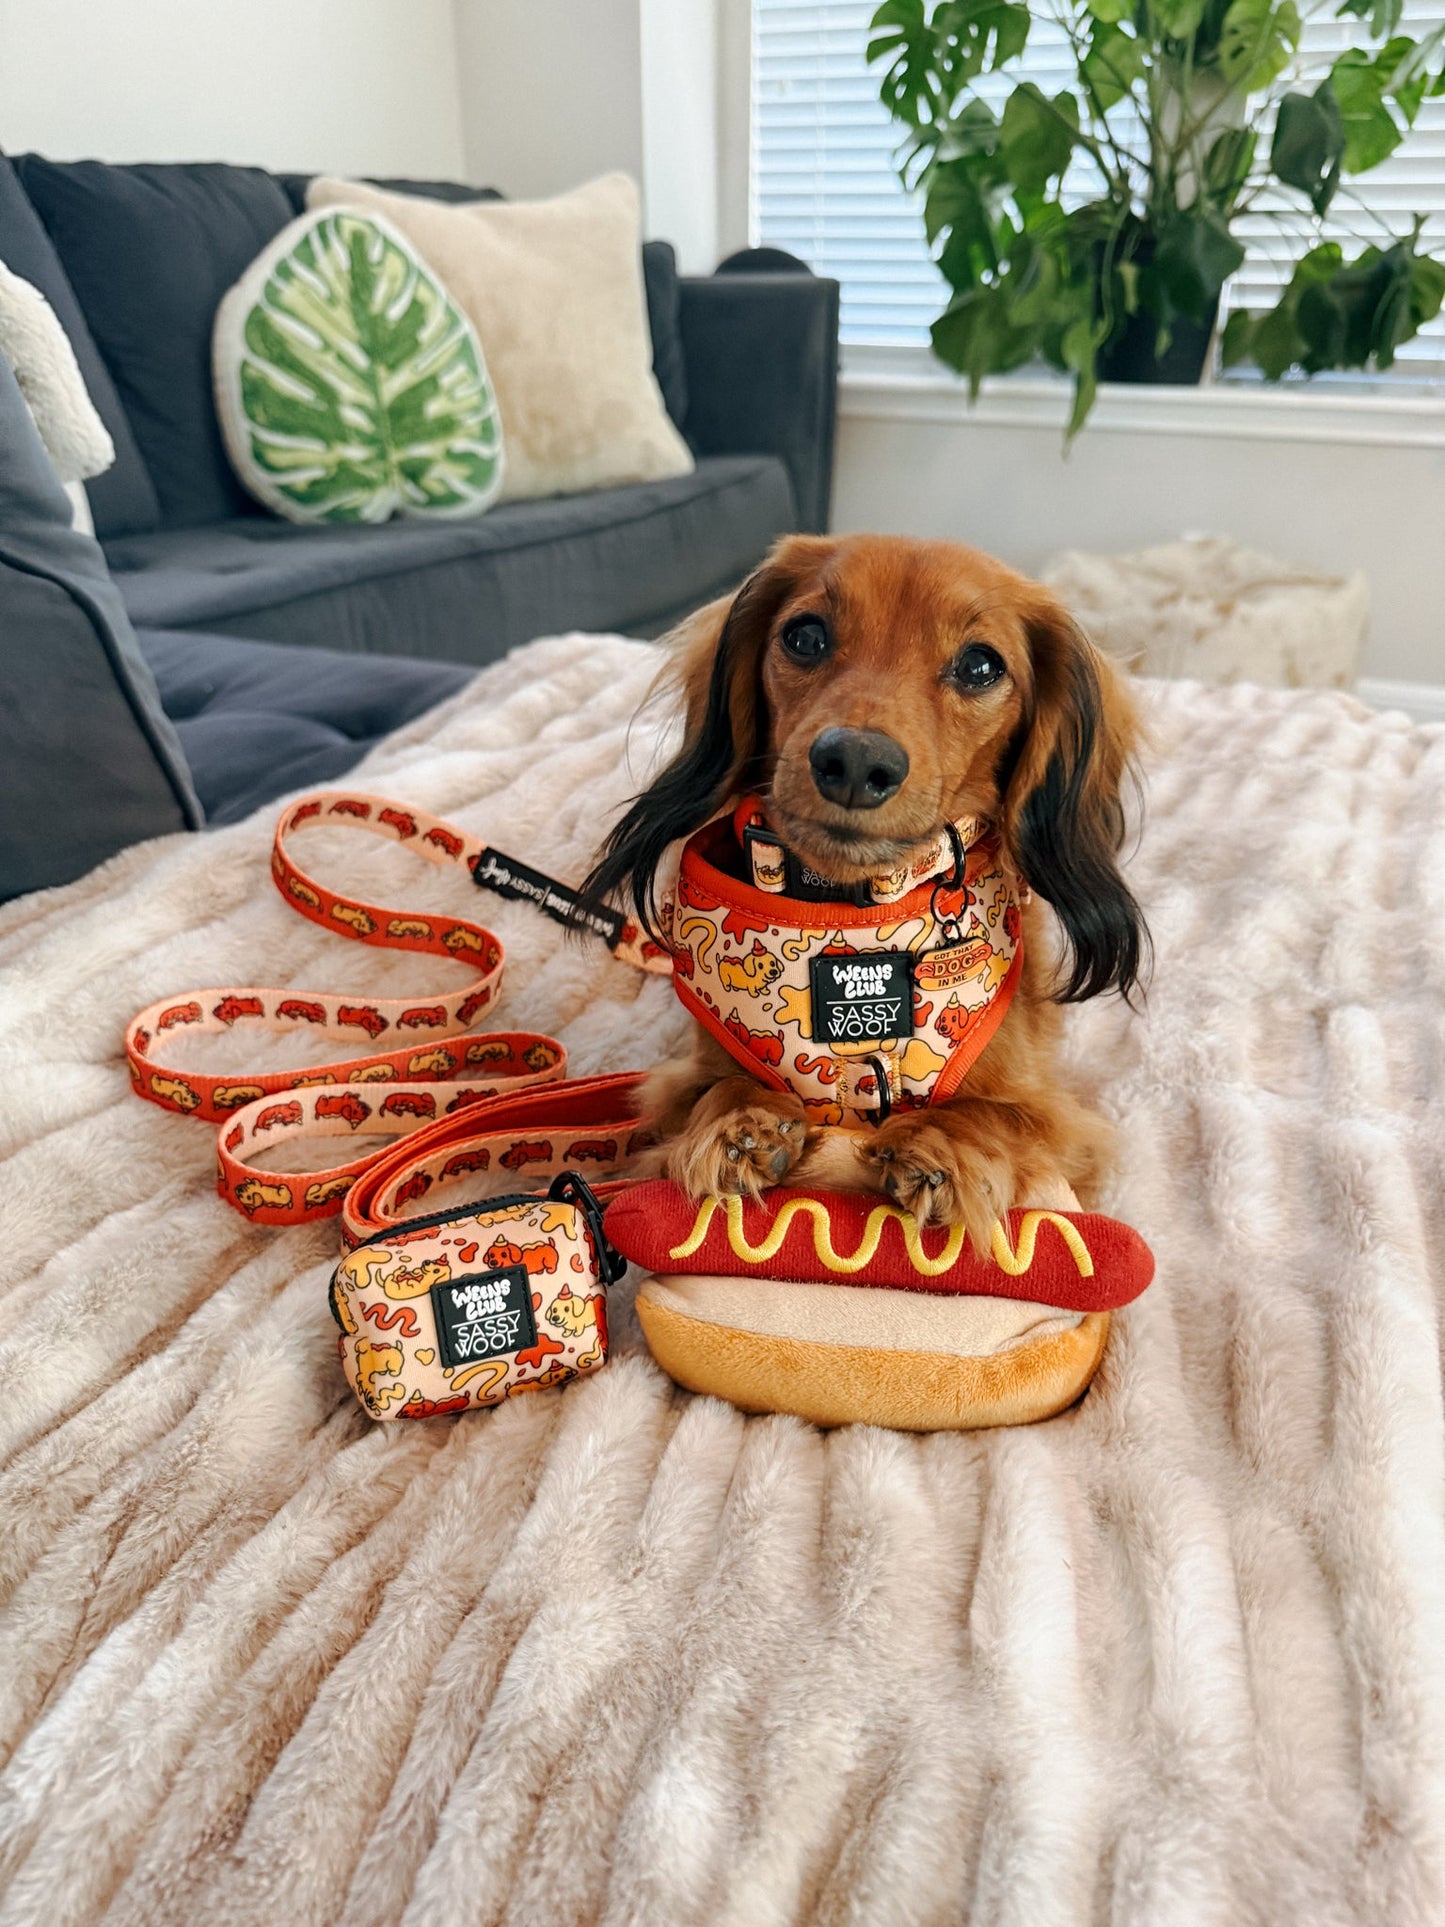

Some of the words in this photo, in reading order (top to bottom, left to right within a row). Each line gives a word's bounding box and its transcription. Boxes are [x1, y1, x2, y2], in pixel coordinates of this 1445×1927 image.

[509, 876, 545, 900] SASSY
[934, 951, 951, 961] GOT
[934, 954, 974, 976] DOG
[832, 964, 893, 985] WEENS
[938, 979, 949, 988] IN
[952, 972, 967, 984] ME
[844, 979, 887, 999] CLUB
[832, 1002, 901, 1023] SASSY
[827, 1017, 898, 1037] WOOF
[451, 1278, 511, 1309] WEENS
[465, 1295, 507, 1321] CLUB
[457, 1313, 521, 1342] SASSY
[454, 1328, 519, 1358] WOOF
